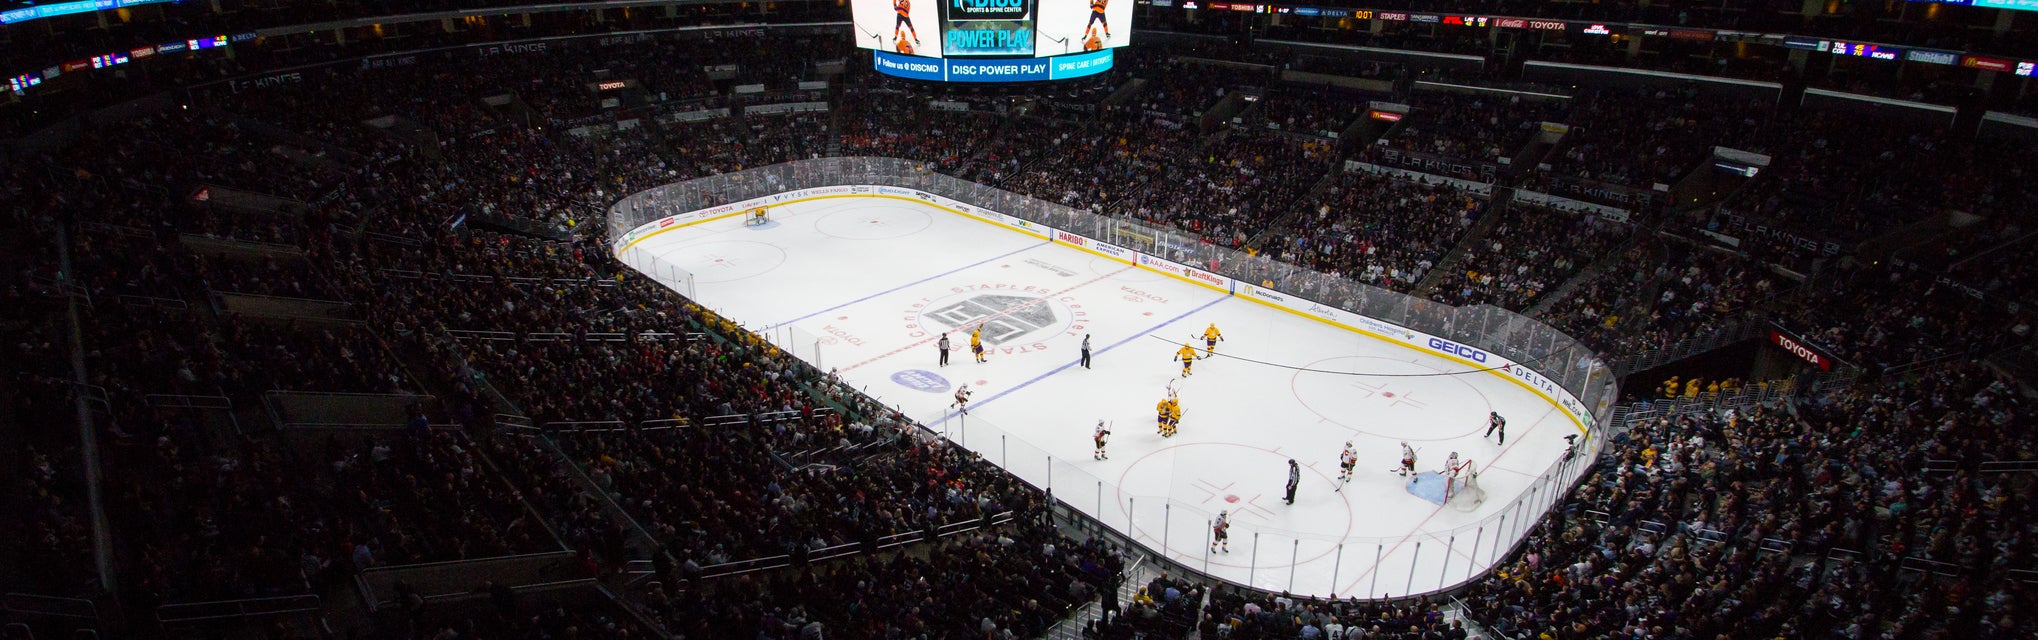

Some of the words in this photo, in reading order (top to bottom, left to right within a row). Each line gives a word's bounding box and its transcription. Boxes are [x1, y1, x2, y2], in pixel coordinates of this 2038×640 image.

[1530, 21, 1565, 30] TOYOTA
[947, 29, 995, 48] POWER
[998, 29, 1031, 48] PLAY
[503, 43, 547, 55] KINGS
[1908, 51, 1955, 65] StubHub!
[882, 59, 896, 69] Follow
[910, 63, 939, 73] DISCMD
[952, 65, 977, 75] DISC
[979, 65, 1018, 75] POWER
[1020, 64, 1046, 74] PLAY
[1058, 62, 1076, 71] SPINE
[1076, 60, 1089, 69] CARE
[599, 82, 625, 90] TOYOTA
[709, 206, 733, 216] TOYOTA
[1058, 231, 1083, 246] HARIBO
[1096, 242, 1124, 254] AMERICAN
[1096, 246, 1120, 257] EXPRESS
[1150, 259, 1179, 273] AAA.com
[1191, 270, 1224, 286] DraftKings
[951, 283, 1051, 295] STAPLES
[1121, 285, 1169, 305] TOYOTA
[1060, 296, 1091, 338] Center
[823, 324, 866, 347] TOYOTA
[1428, 337, 1487, 363] GEICO
[1778, 335, 1819, 364] TOYOTA
[1515, 367, 1553, 394] DELTA
